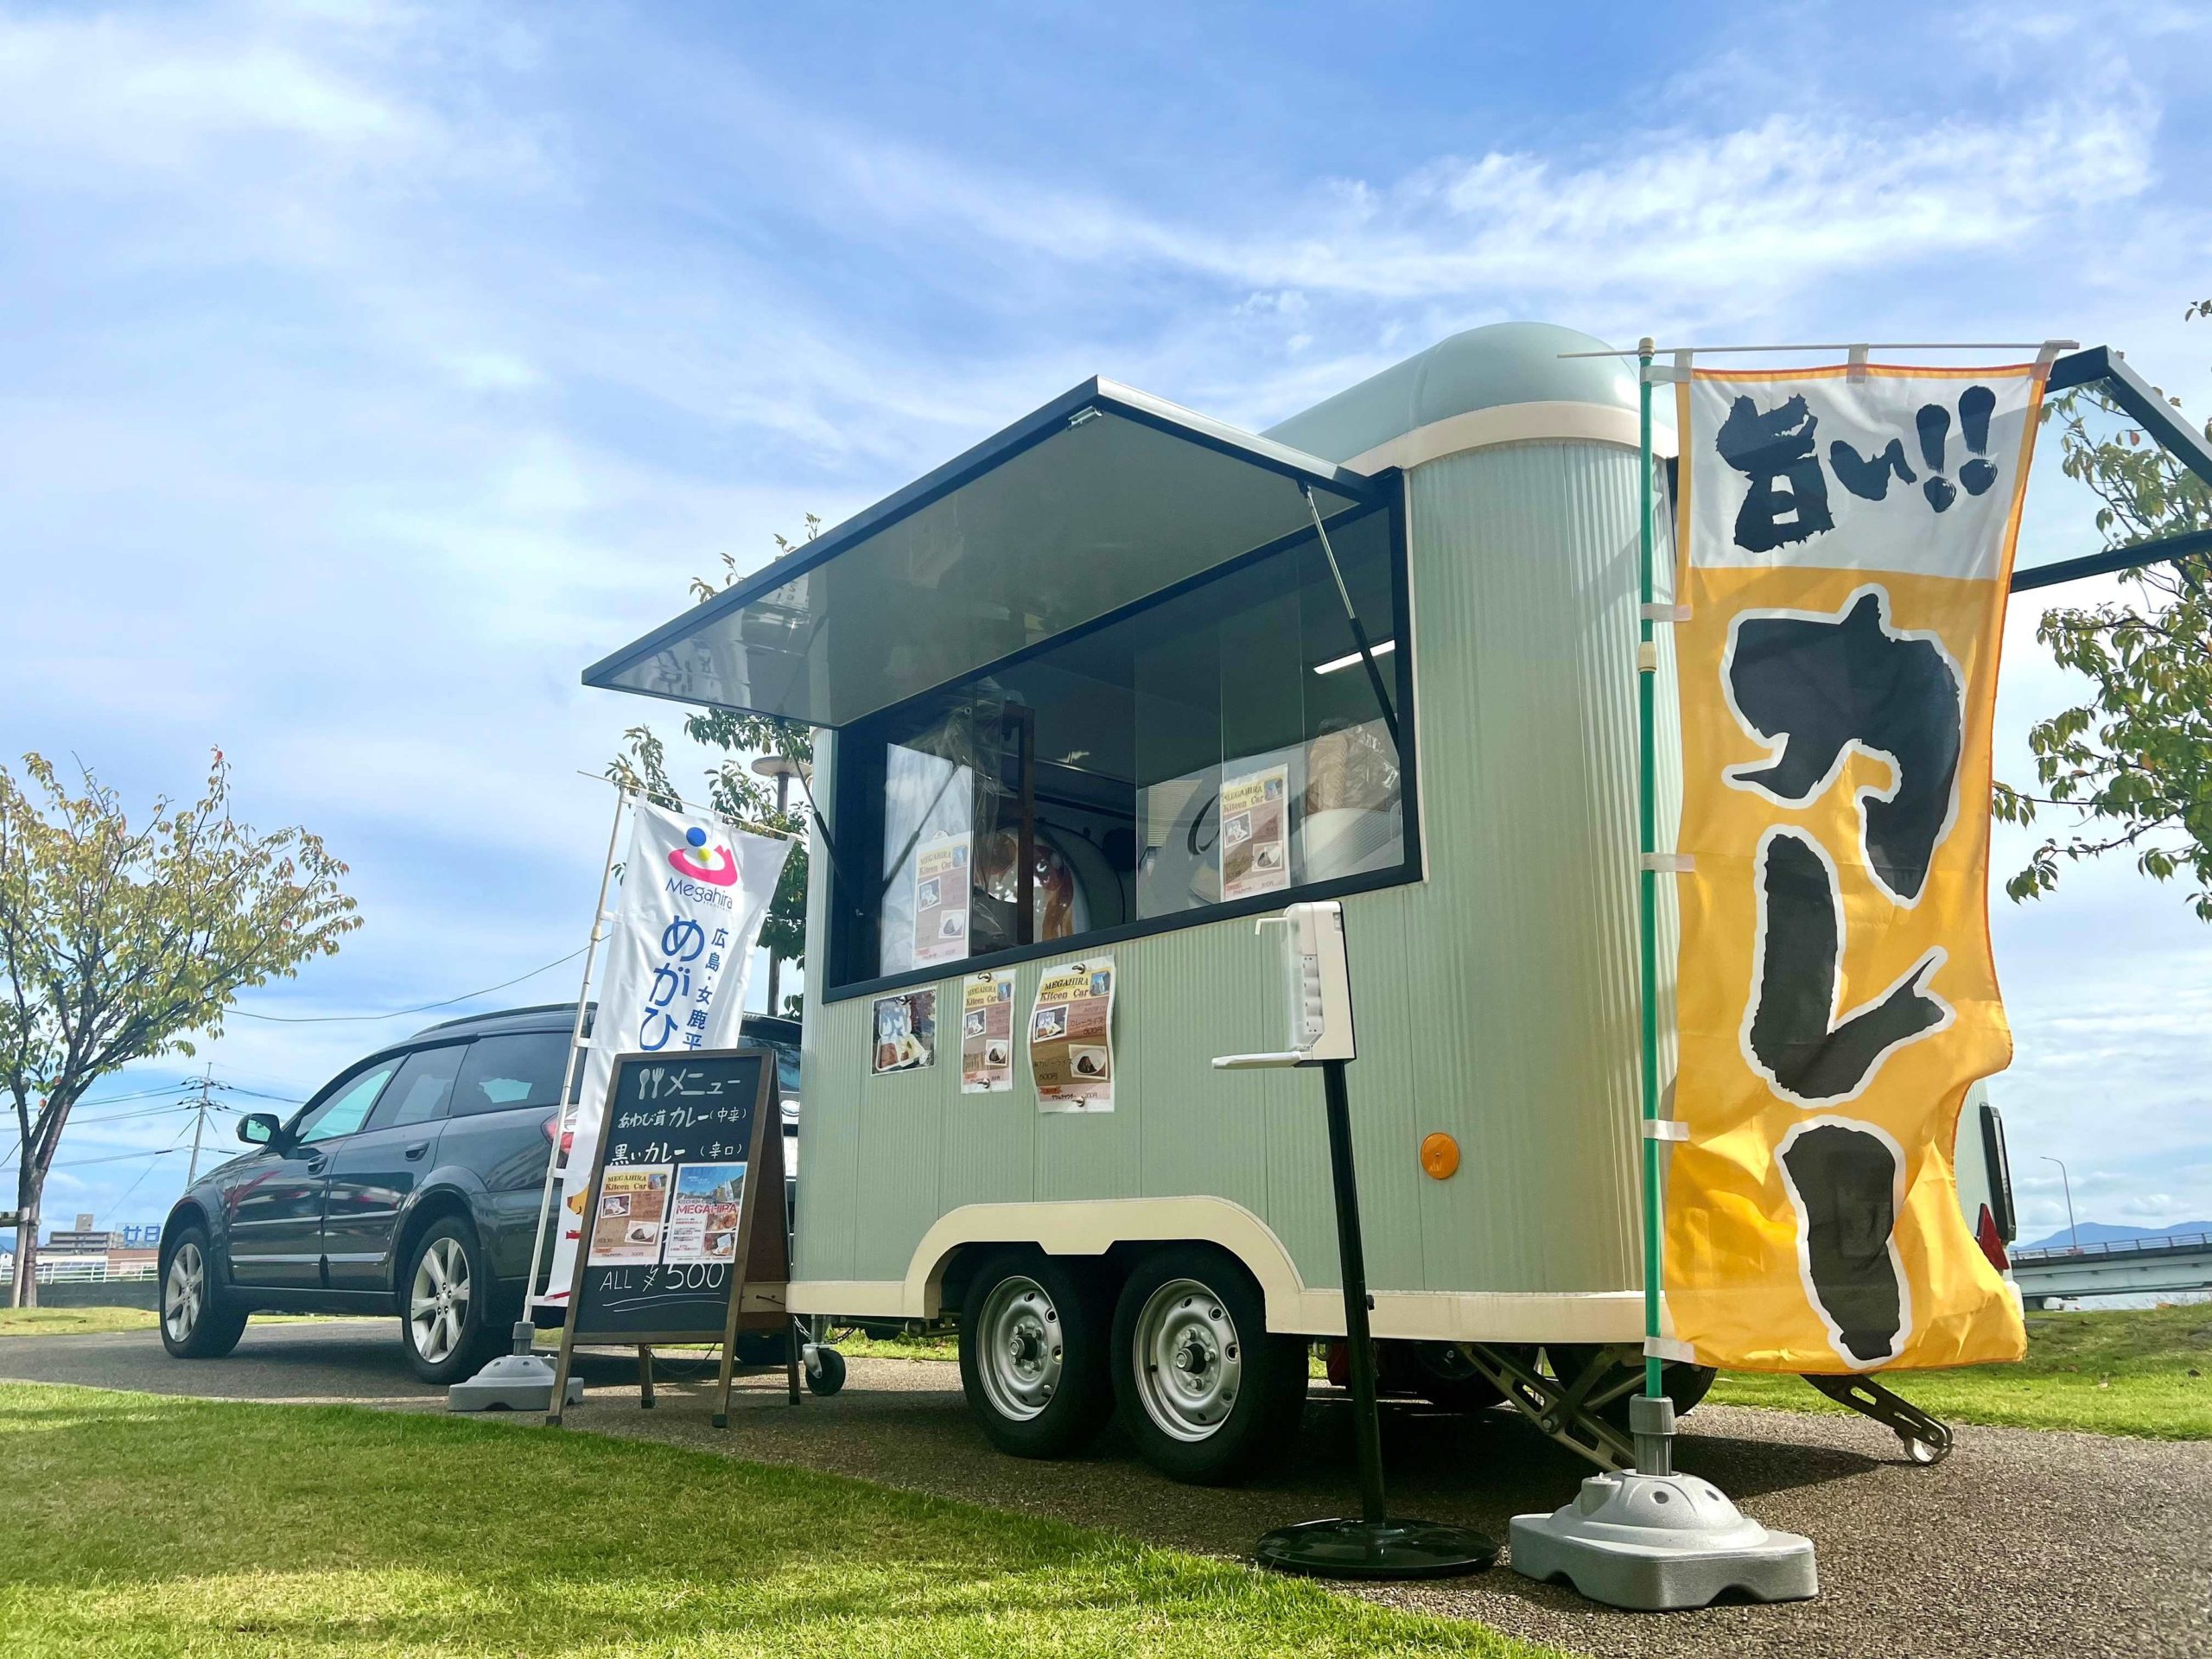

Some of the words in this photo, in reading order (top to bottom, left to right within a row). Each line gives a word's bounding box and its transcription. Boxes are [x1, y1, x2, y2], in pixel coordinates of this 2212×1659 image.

[665, 877, 733, 910] Megahira
[639, 915, 704, 1051] めがひ
[1044, 977, 1089, 991] MEGAHIRA
[1720, 584, 1966, 1368] カレー
[967, 986, 996, 996] MEGAHIRA
[1073, 988, 1089, 997] Car
[664, 1068, 741, 1096] メニュー
[609, 1141, 686, 1166] 黒いカレー
[607, 1174, 647, 1183] MEGAHIRA
[676, 1204, 738, 1215] MEGAHIRA
[600, 1269, 632, 1292] ALL
